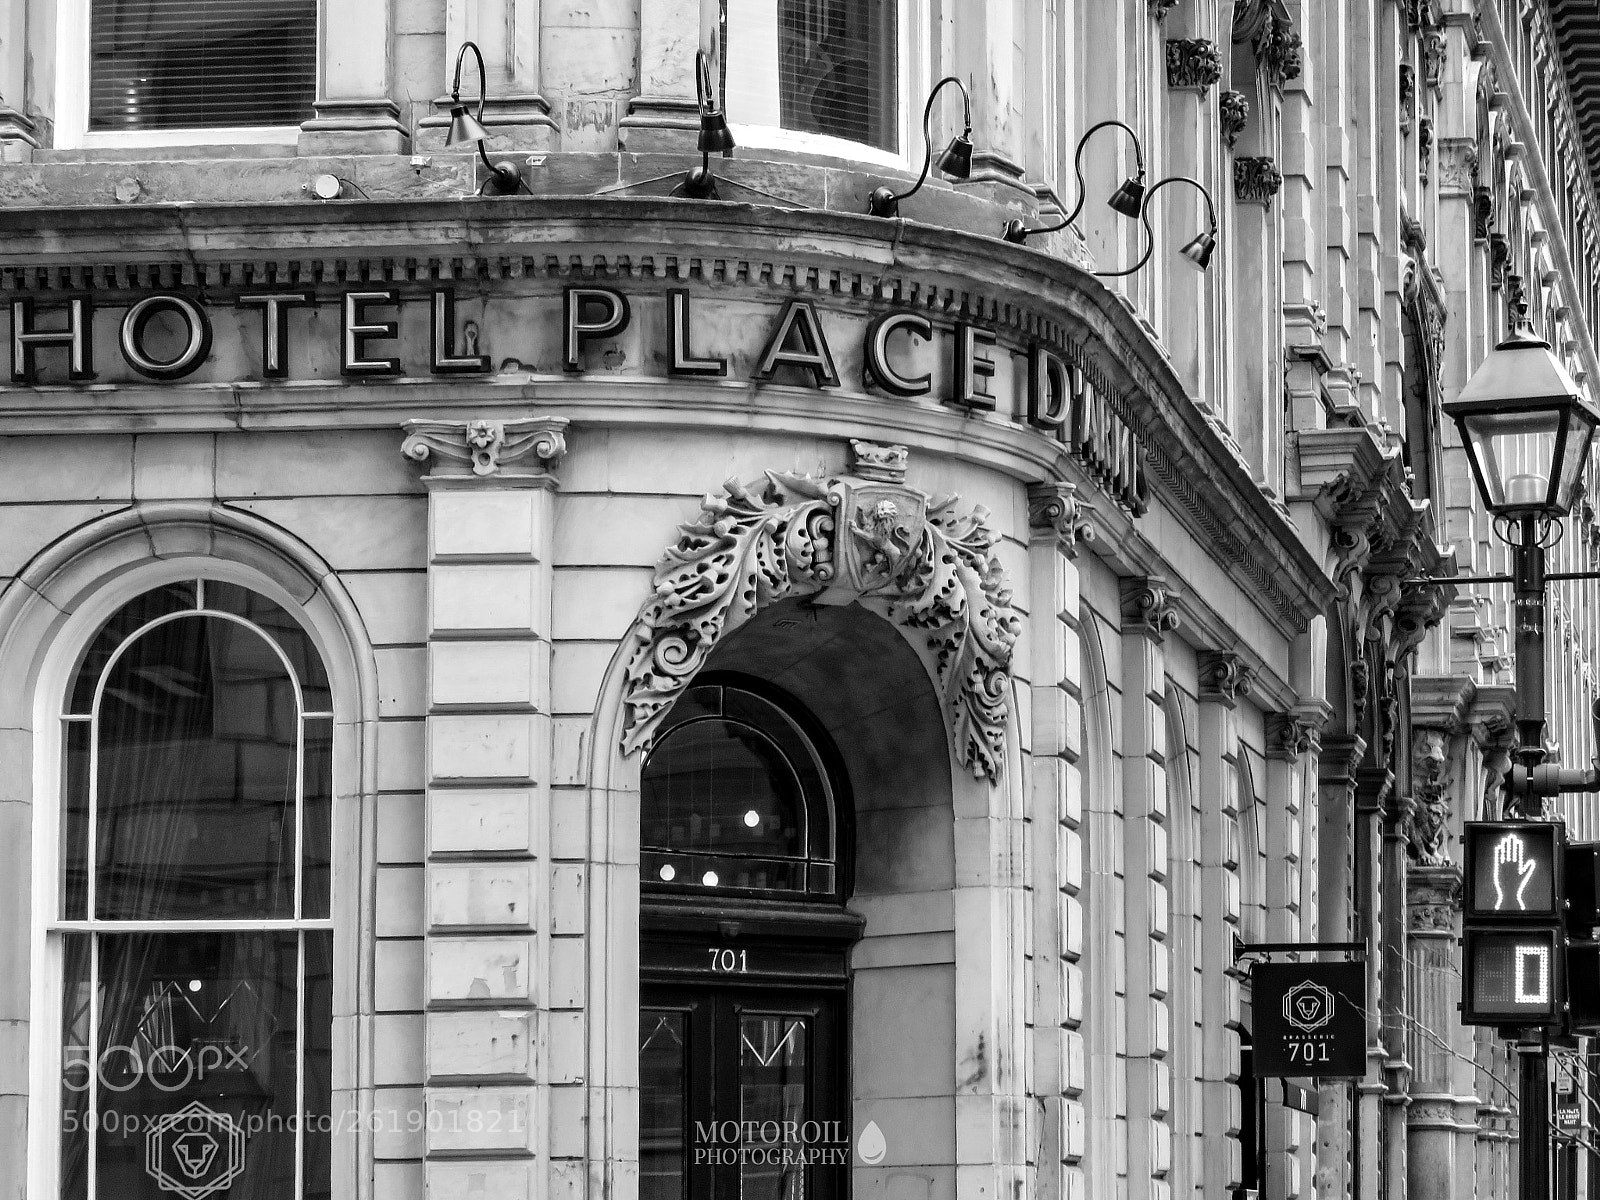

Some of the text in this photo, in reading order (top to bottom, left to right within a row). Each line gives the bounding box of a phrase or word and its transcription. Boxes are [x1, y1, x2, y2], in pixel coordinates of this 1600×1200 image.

[10, 288, 491, 380] HOTEL
[562, 285, 998, 412] PLACE
[708, 948, 748, 974] 701
[1515, 945, 1548, 1004] 0
[1288, 1042, 1330, 1062] 701
